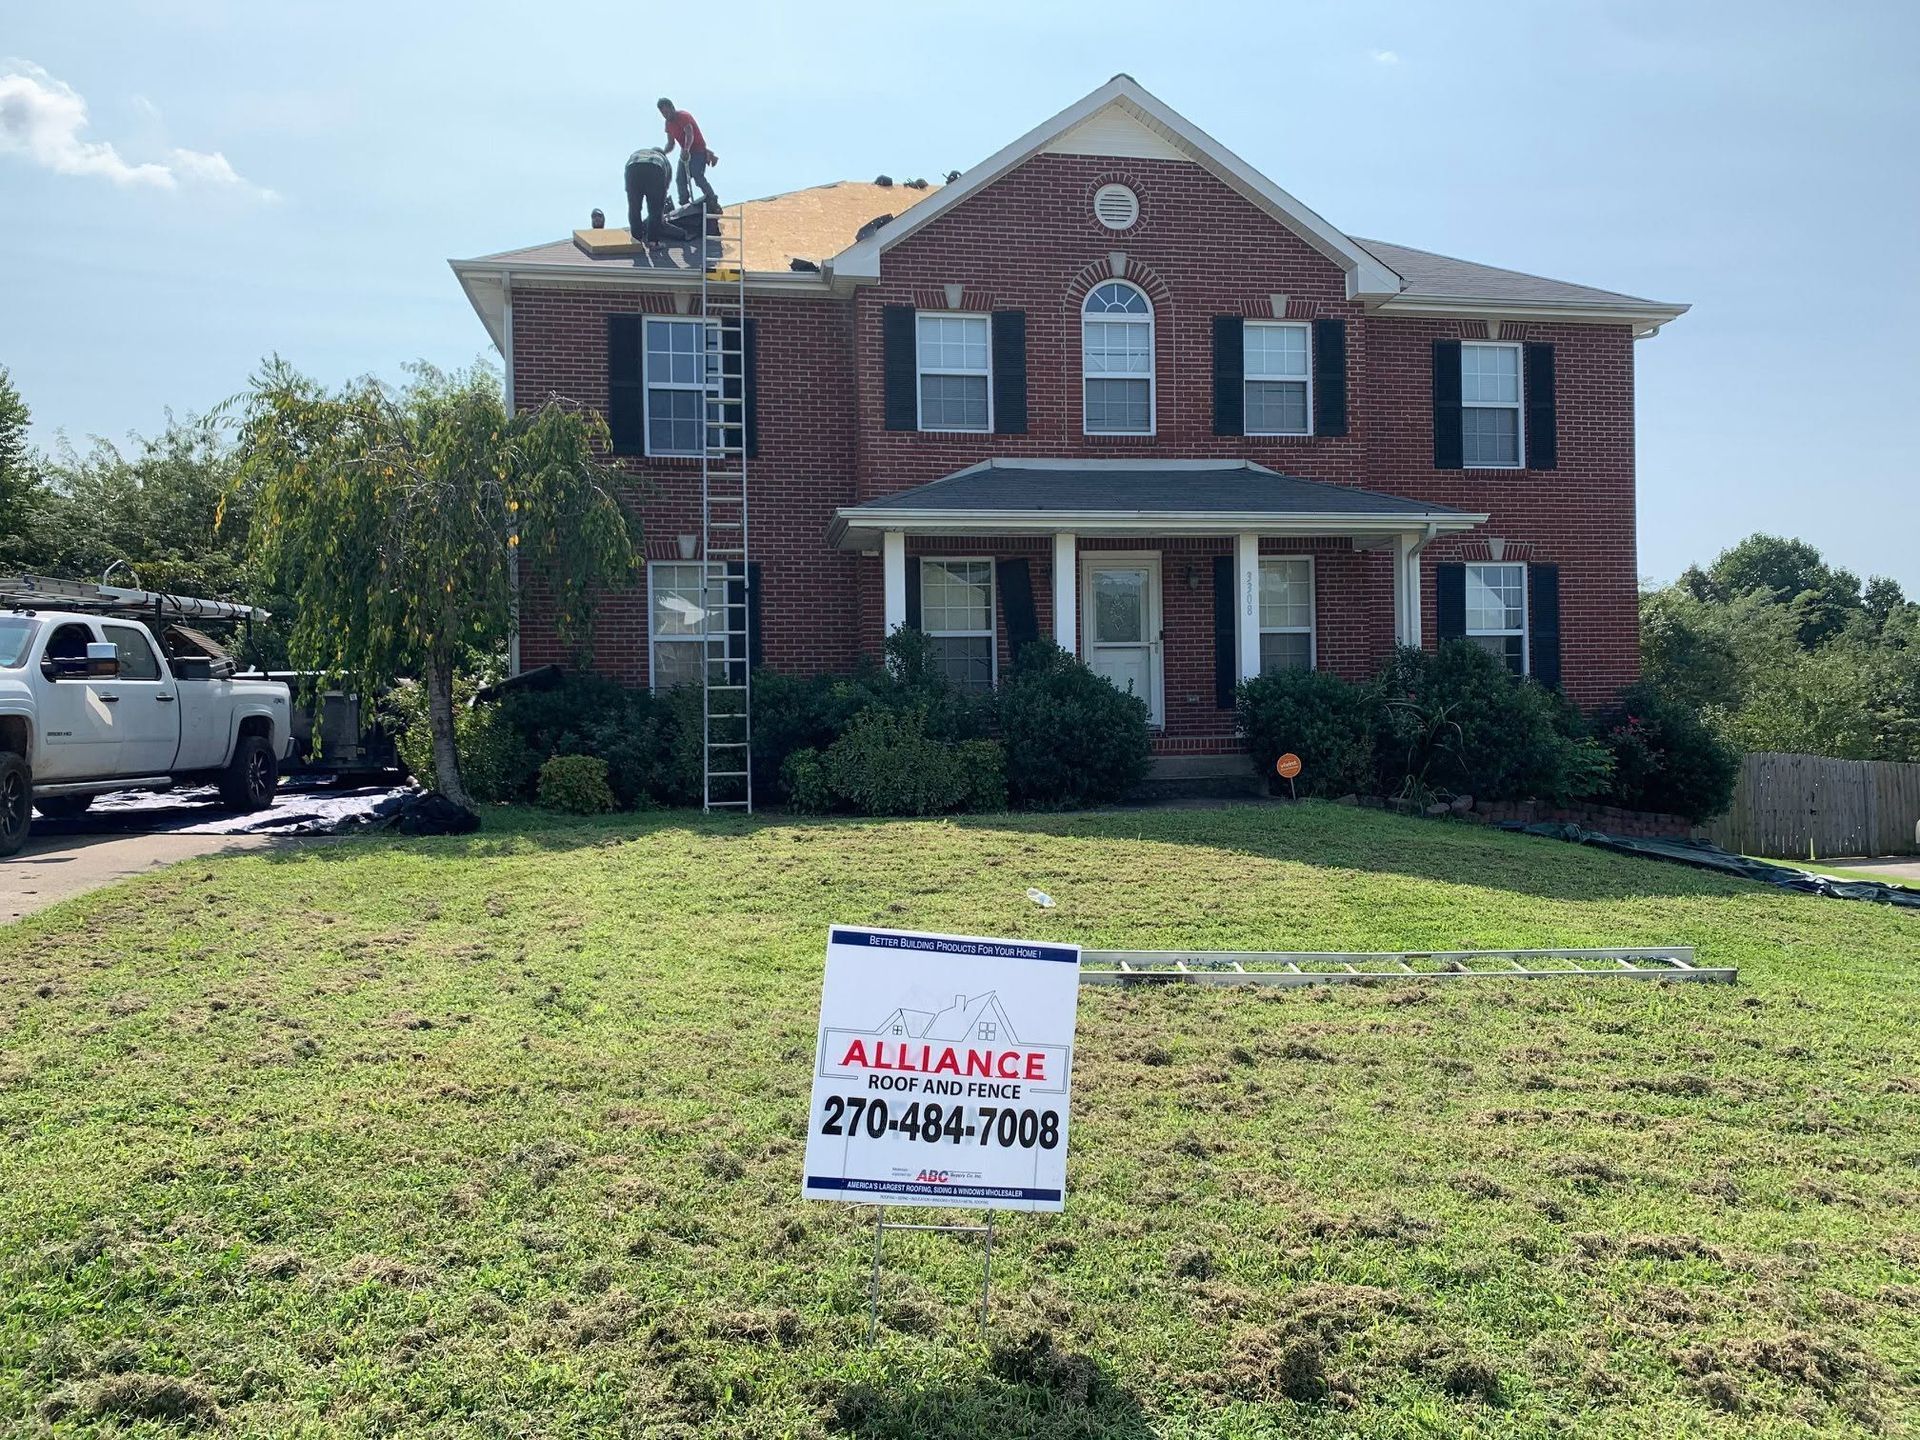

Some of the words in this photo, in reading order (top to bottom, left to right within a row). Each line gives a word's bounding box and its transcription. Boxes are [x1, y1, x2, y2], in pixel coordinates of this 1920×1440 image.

[869, 935, 899, 946] BETTER
[900, 938, 935, 950] BUILDING
[936, 941, 976, 954] PRODUCTS
[978, 944, 994, 954] FOR
[994, 946, 1015, 956] YOUR
[1016, 948, 1038, 958] HOME
[838, 1039, 1046, 1080] ALLIANCE
[868, 1074, 918, 1092] ROOF
[922, 1079, 963, 1096] AND
[968, 1082, 1021, 1100] FENCE
[822, 1095, 1060, 1150] 270-484-7008
[916, 1169, 948, 1182] ABC
[847, 1180, 878, 1190] AMERICA'S
[880, 1183, 906, 1192] LARGEST
[934, 1186, 952, 1194] SIDING
[958, 1188, 985, 1196] WINDOWS
[986, 1189, 1023, 1198] WHOLESALER
